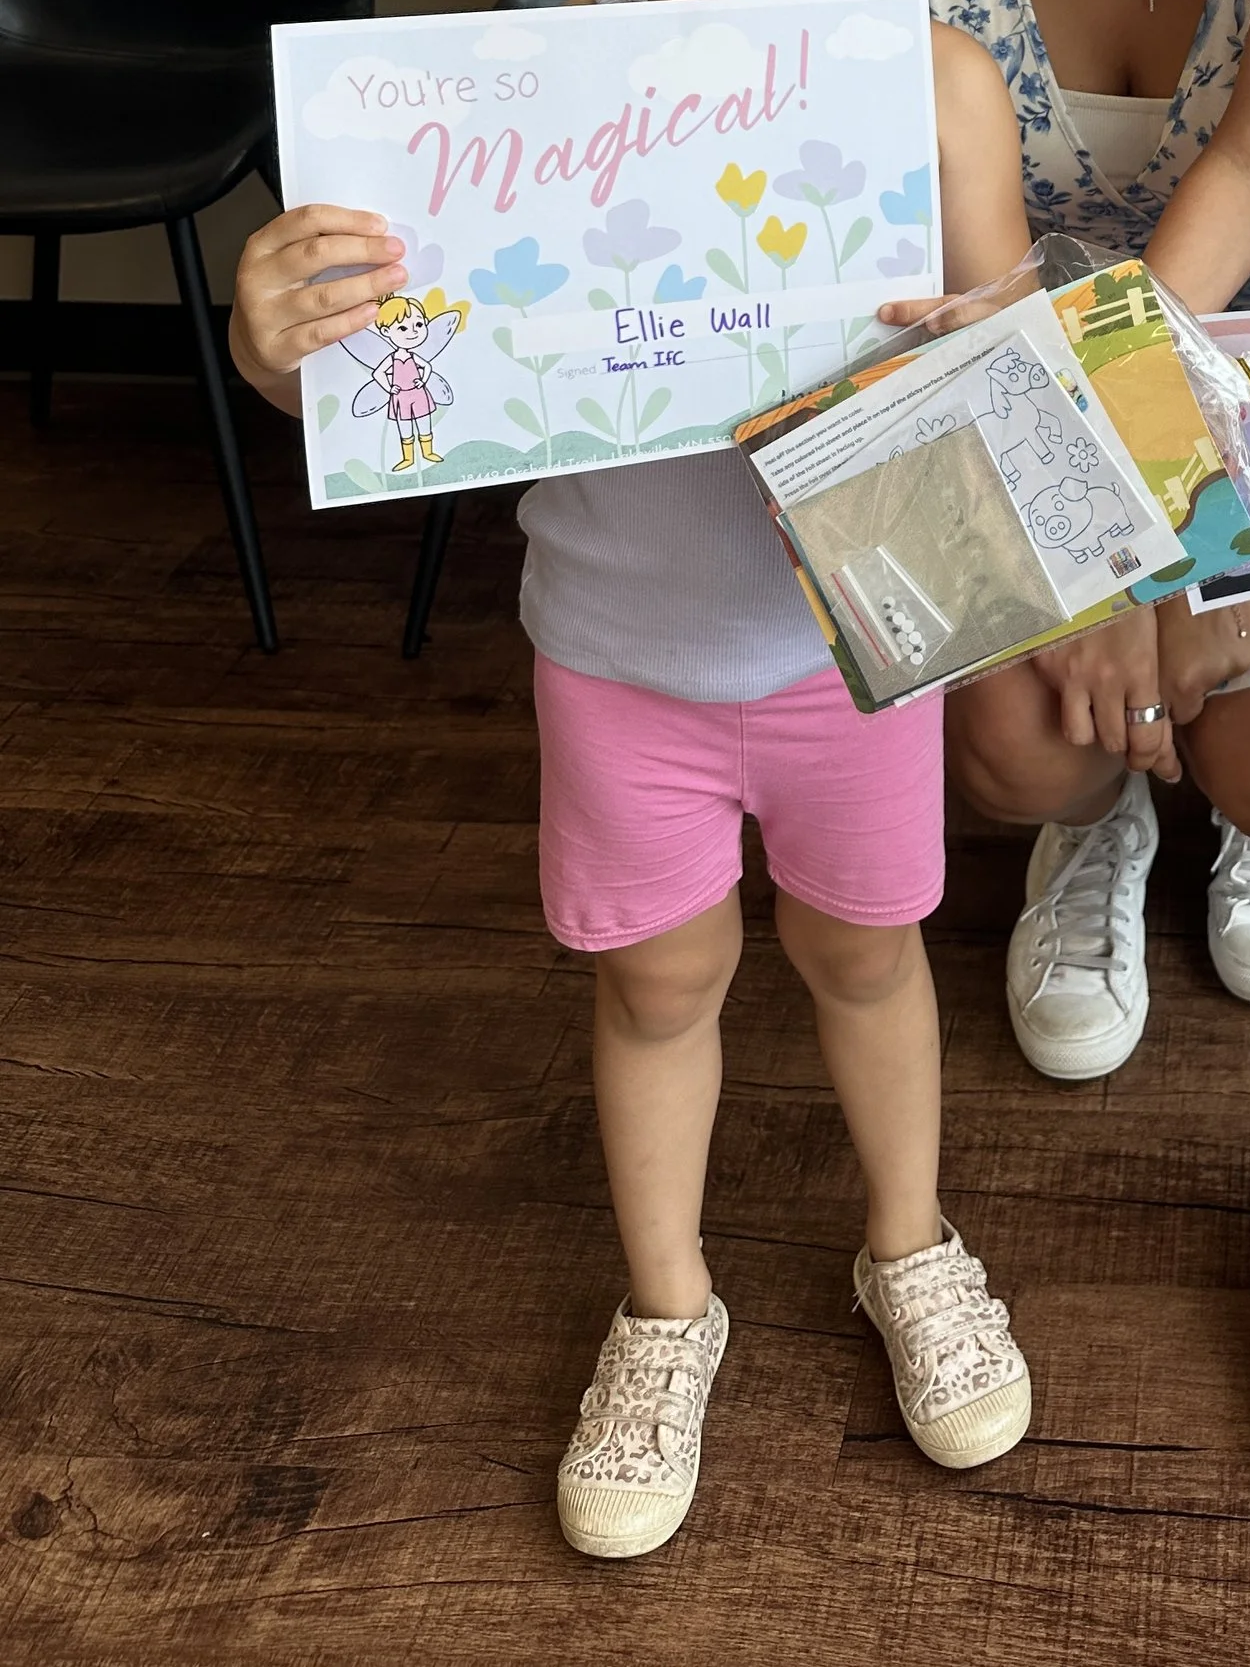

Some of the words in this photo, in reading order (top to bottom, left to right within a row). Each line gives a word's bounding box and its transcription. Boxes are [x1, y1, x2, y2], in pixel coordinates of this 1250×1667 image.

[347, 70, 478, 110] You're
[494, 70, 539, 102] so
[407, 28, 809, 217] Magical!
[615, 307, 686, 344] Ellie
[710, 302, 771, 333] Wall
[556, 364, 597, 380] Signed
[602, 356, 648, 374] Team
